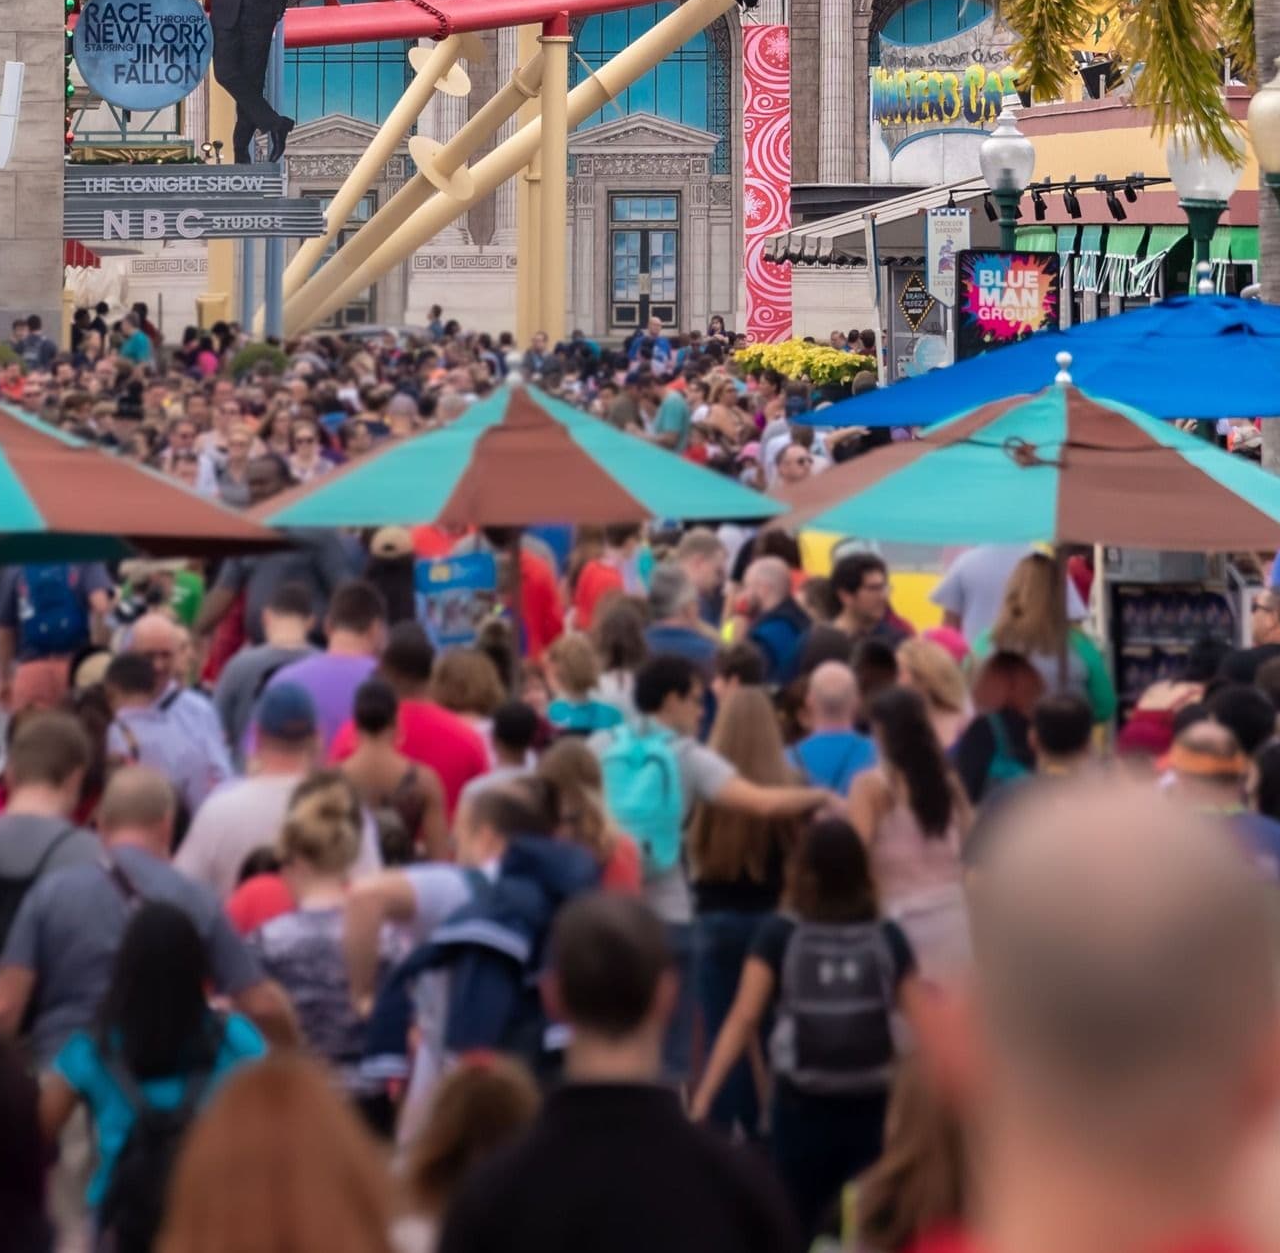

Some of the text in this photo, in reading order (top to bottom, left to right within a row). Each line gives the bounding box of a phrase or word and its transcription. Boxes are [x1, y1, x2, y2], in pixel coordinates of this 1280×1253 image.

[85, 2, 204, 24] RACE THROUGH
[84, 23, 208, 44] NEW YORK
[84, 43, 206, 64] STARRING JIMMY
[114, 63, 201, 84] FALLON
[82, 175, 265, 194] THE TONIGHT SHOW
[211, 216, 284, 230] STUDIOS
[979, 269, 1039, 288] BLUE
[978, 287, 1039, 308] MAN
[978, 307, 1039, 321] GROUP
